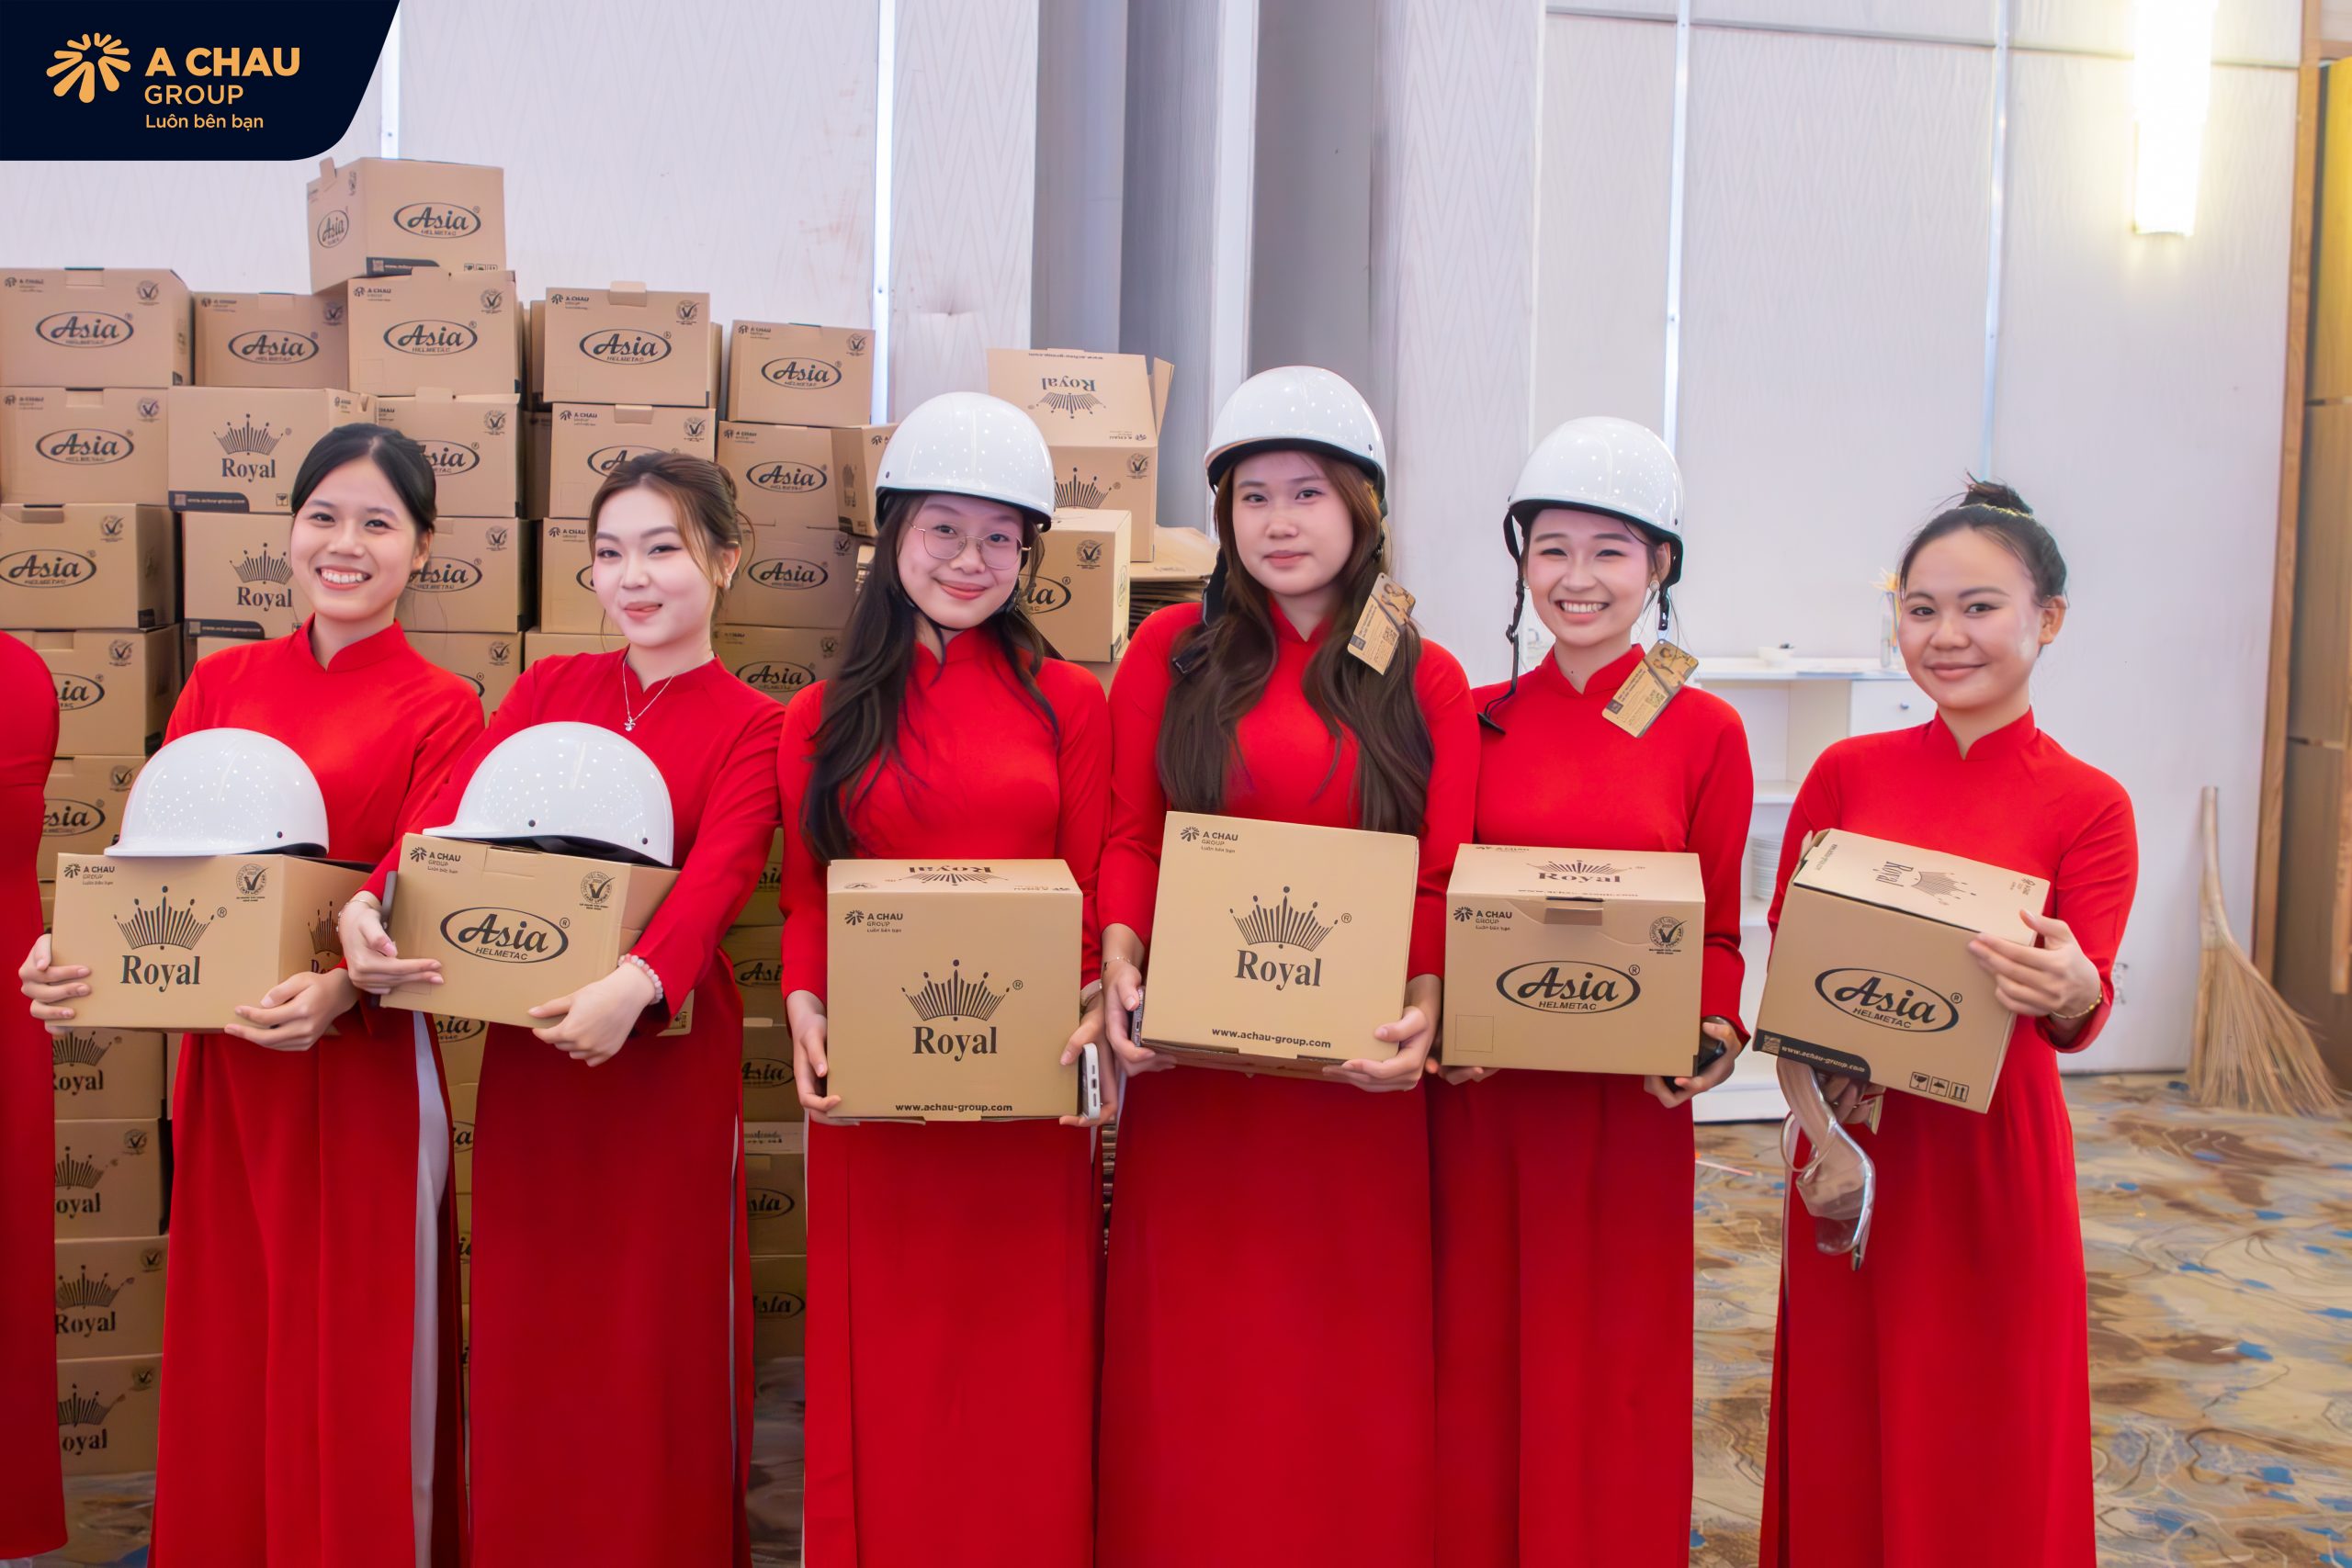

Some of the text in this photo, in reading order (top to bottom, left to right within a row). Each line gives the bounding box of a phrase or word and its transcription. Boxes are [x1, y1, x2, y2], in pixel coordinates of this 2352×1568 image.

[407, 206, 469, 231] Asia
[51, 315, 120, 340] Asia
[398, 323, 464, 347] Asia
[242, 333, 307, 356] Asia
[593, 333, 659, 357] Asia
[773, 361, 831, 383] Asia
[1041, 376, 1097, 393] Royal
[51, 433, 120, 457] Asia
[421, 445, 467, 468] sia
[220, 457, 277, 483] Royal
[758, 464, 816, 487] Asia
[8, 554, 82, 579] Asia
[760, 561, 817, 583] Asia
[236, 585, 293, 612] Royal
[747, 664, 804, 685] Asia
[58, 680, 90, 702] ia
[44, 806, 91, 828] sia
[1203, 830, 1239, 841] A CHAU
[436, 852, 461, 863] CHAU
[83, 865, 116, 874] A CHAU
[1537, 872, 1621, 884] Royal
[867, 912, 904, 920] A CHAU
[1476, 909, 1513, 919] A CHAU
[458, 913, 549, 953] Asia
[474, 946, 529, 961] HELMETAC
[119, 953, 201, 993] Royal
[741, 962, 782, 982] Asi
[1234, 948, 1323, 991] Royal
[1517, 965, 1620, 1002] Asia
[1538, 1000, 1597, 1011] HELMETAC
[1833, 976, 1937, 1024] Asia
[436, 1016, 473, 1034] sia
[1852, 1007, 1912, 1030] HELMETAC
[911, 1025, 999, 1063] Royal
[1211, 1027, 1332, 1049] www.achau-group.com
[895, 1103, 1013, 1114] www.achau-group.com
[56, 1192, 101, 1219] oyal
[747, 1194, 782, 1212] sia
[753, 1294, 792, 1314] sia
[54, 1311, 116, 1338] Royal
[62, 1427, 107, 1456] oyal
